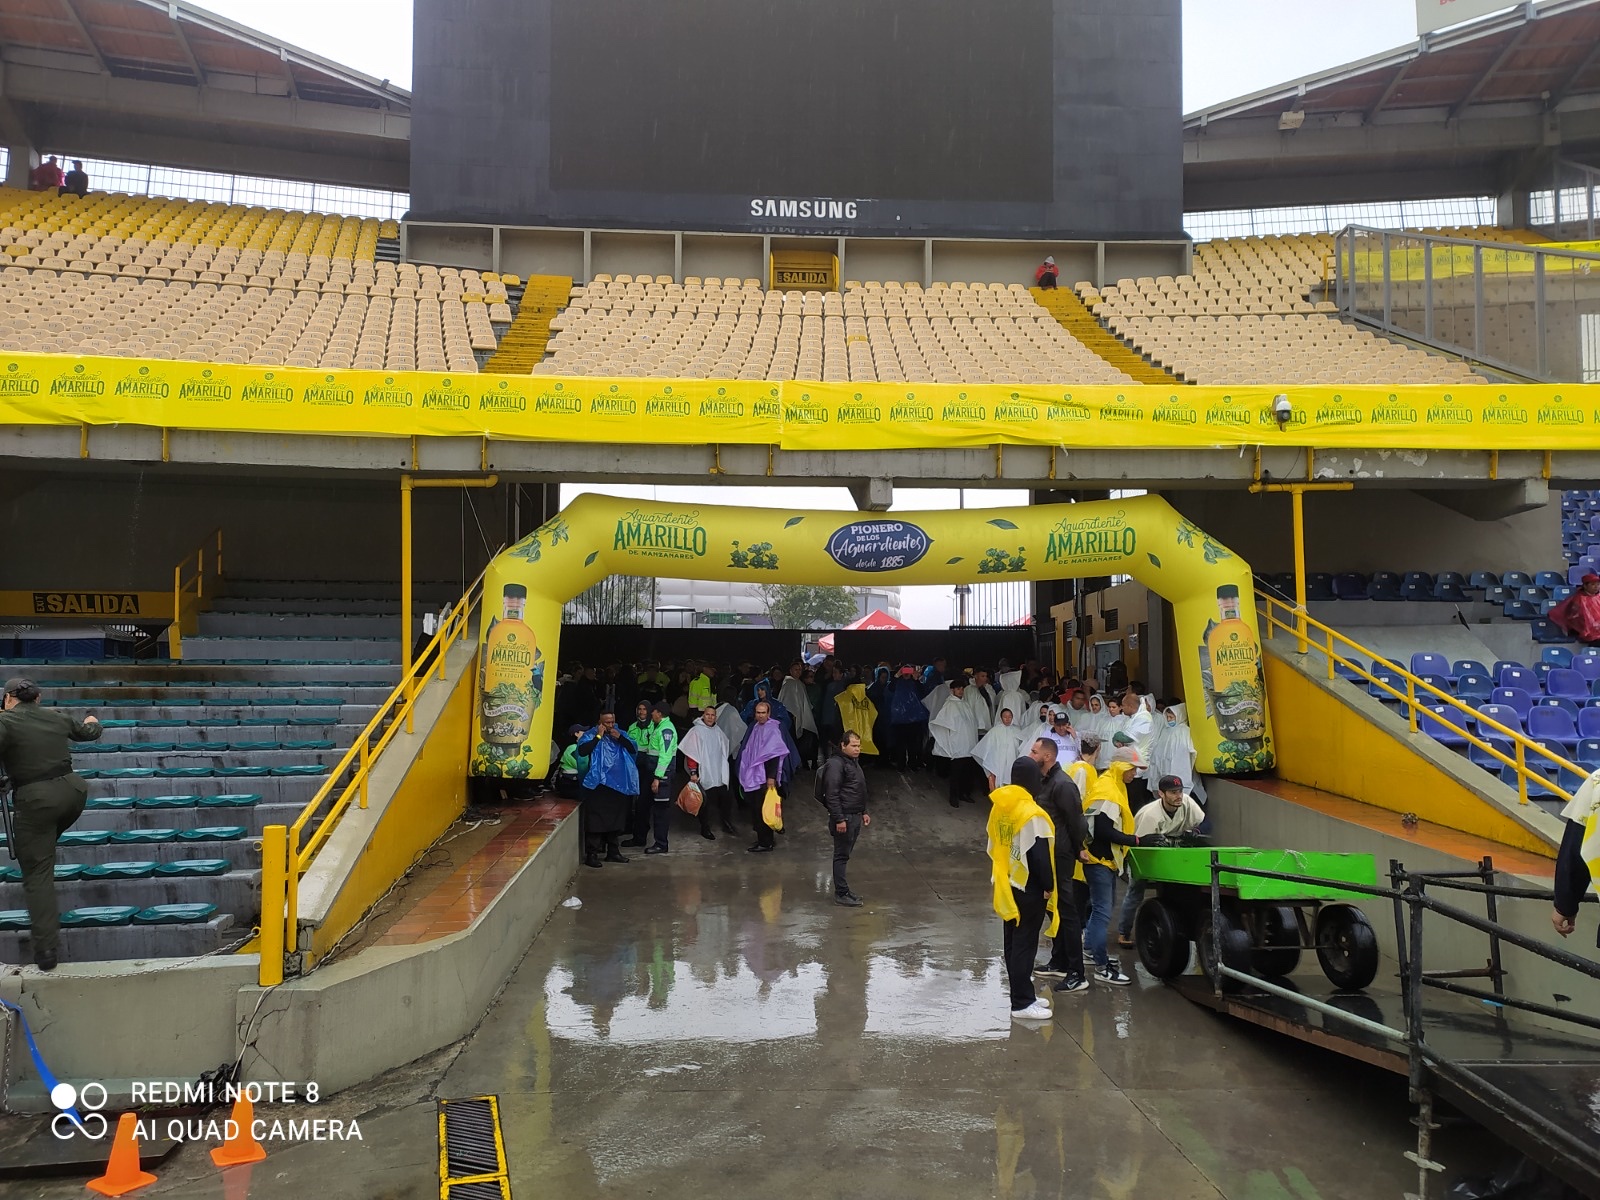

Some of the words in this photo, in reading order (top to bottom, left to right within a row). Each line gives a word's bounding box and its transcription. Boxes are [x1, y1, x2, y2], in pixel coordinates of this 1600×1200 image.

[751, 199, 857, 219] SAMSUNG
[783, 272, 826, 283] SALIDA
[0, 379, 39, 394] ARILLO
[49, 379, 105, 395] AMARILLO
[115, 381, 169, 398] AMARILLO
[179, 383, 232, 400] AMARILLO
[241, 385, 293, 402] AMARILLO
[303, 388, 354, 405] AMARILLO
[363, 390, 413, 406] AMARILLO
[422, 393, 470, 410] AMARILLO
[479, 394, 526, 411] AMARILLO
[535, 397, 582, 413] AMARILLO
[590, 398, 637, 414] AMARILLO
[645, 400, 691, 416] AMARILLO
[699, 402, 744, 417] AMARILLO
[753, 402, 780, 417] AMARI
[785, 407, 829, 423] AMARILLO
[837, 406, 881, 422] AMARILLO
[890, 406, 934, 421] AMARILLO
[942, 406, 986, 421] AMARILLO
[995, 406, 1038, 421] AMARILLO
[1047, 406, 1091, 421] AMARILLO
[1152, 408, 1197, 424] AMARILLO
[1205, 409, 1251, 424] AMARILLO
[1259, 409, 1307, 425] AMLLO
[1316, 409, 1362, 424] AMARILLO
[1371, 409, 1417, 424] AMARILLO
[1427, 408, 1473, 423] AMARILLO
[1482, 408, 1528, 423] AMARILLO
[1537, 409, 1584, 424] AMARILLO
[621, 509, 700, 530] Aguardiente
[1051, 510, 1126, 537] Aguardiente
[851, 523, 904, 535] PIONERO
[613, 520, 707, 557] AMARILLO
[835, 533, 922, 558] Aguardientes
[1044, 527, 1136, 563] AMARILLO
[641, 550, 695, 560] MANZANARES
[855, 558, 877, 569] desde
[880, 555, 906, 569] 1885
[1071, 555, 1122, 564] MANZANARES
[36, 595, 45, 612] EXIT
[47, 594, 138, 614] SALIDA
[490, 649, 531, 667] AMARILLO
[1216, 647, 1254, 666] AMARILLO
